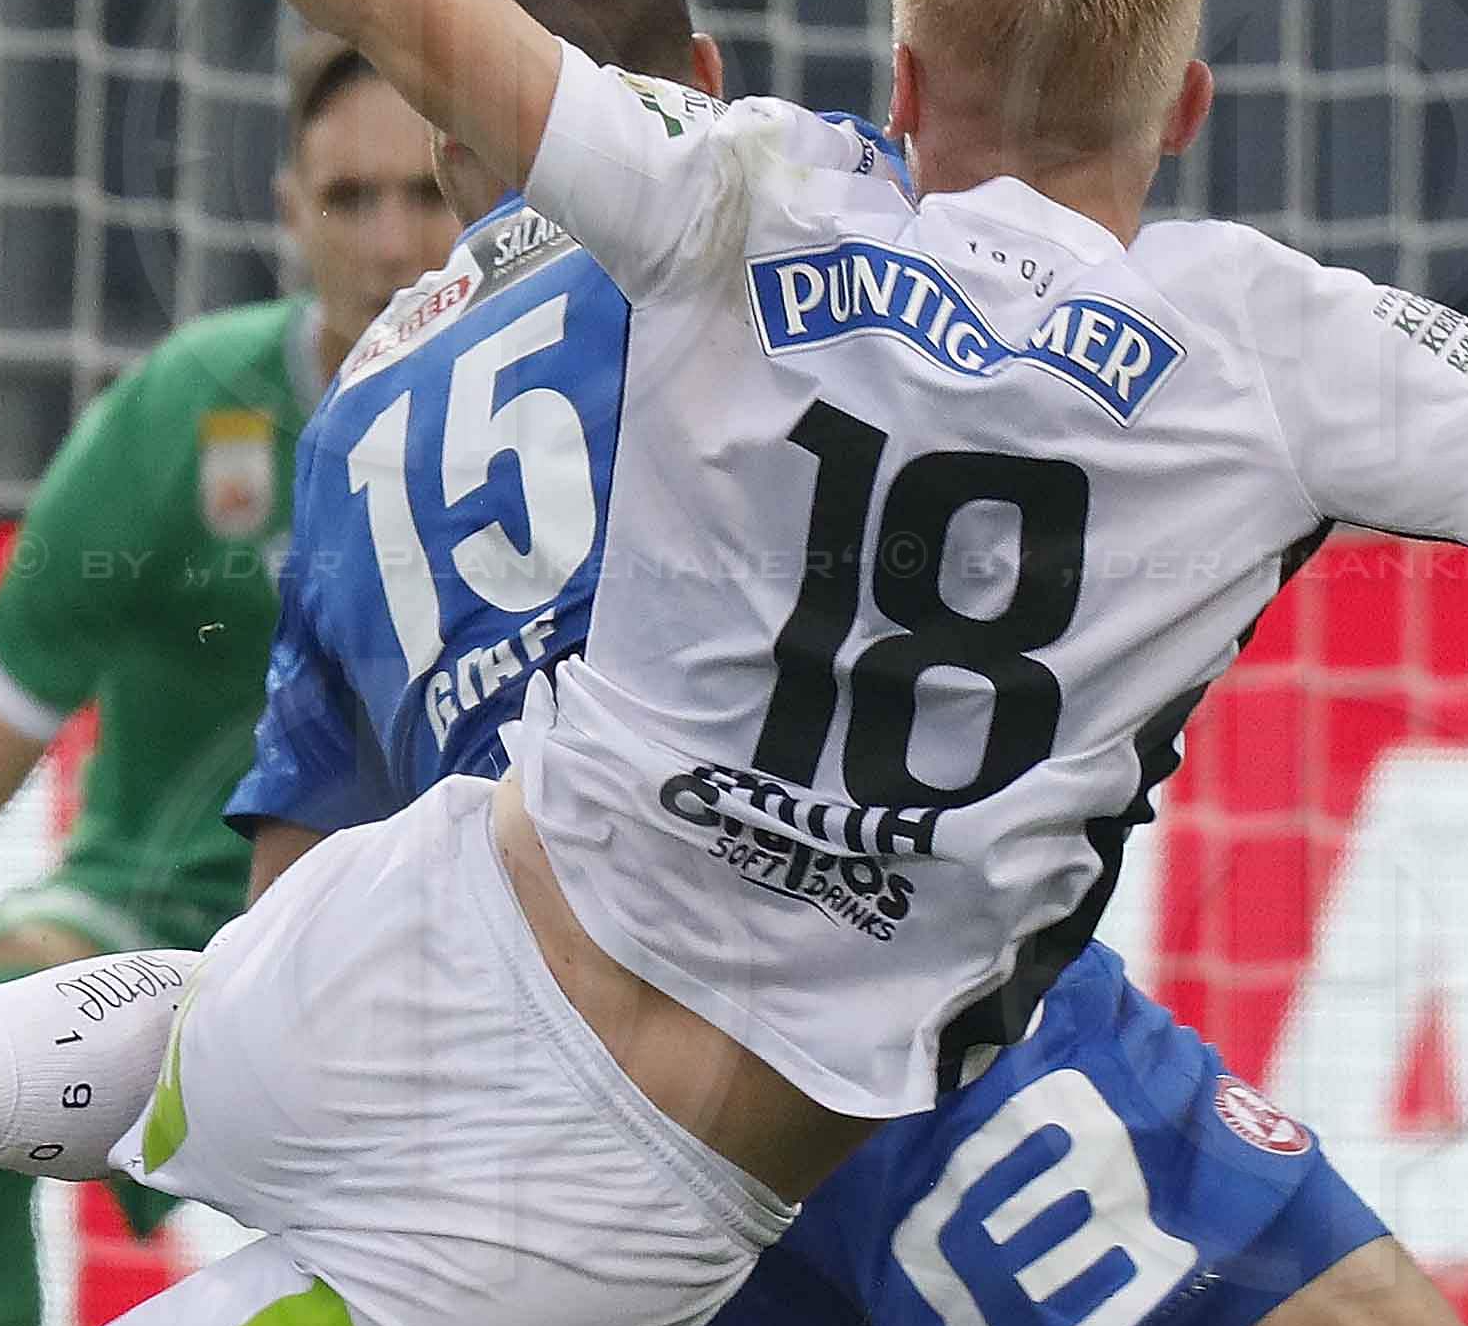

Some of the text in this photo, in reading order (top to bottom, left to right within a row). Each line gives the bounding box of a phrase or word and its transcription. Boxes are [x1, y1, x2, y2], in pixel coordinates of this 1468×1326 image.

[347, 292, 599, 685] 15
[750, 396, 1090, 810] 18
[707, 835, 897, 942] SOFT DRINKS
